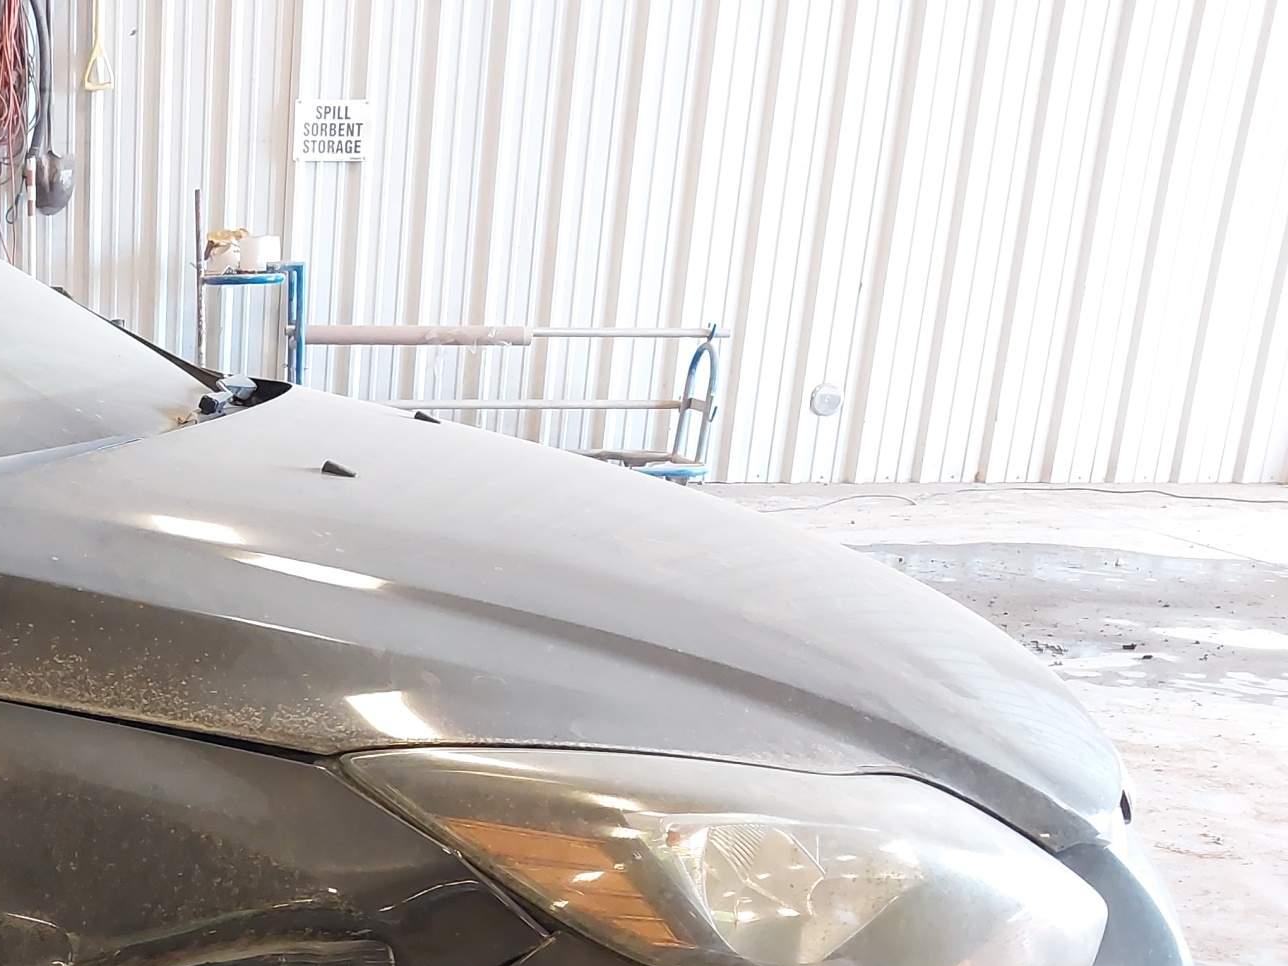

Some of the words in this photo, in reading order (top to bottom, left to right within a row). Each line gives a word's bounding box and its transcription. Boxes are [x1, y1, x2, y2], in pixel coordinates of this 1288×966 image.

[315, 105, 352, 120] SPILL
[303, 122, 364, 137] SORBENT
[302, 139, 362, 154] STORAGE
